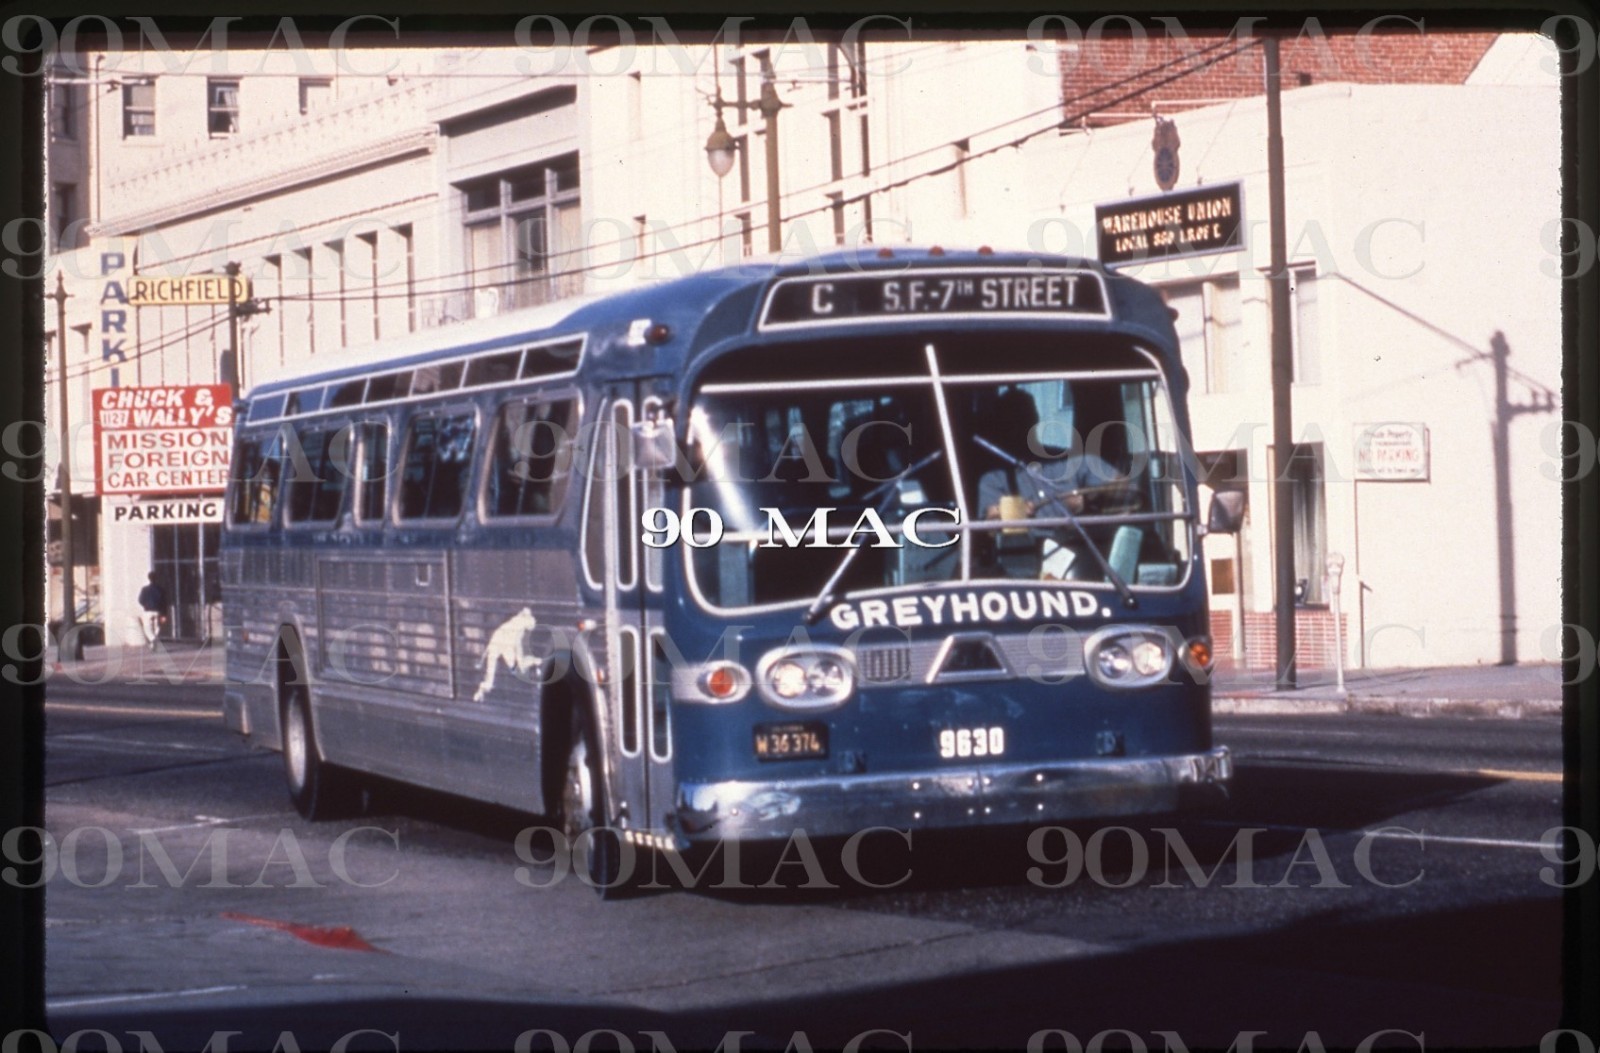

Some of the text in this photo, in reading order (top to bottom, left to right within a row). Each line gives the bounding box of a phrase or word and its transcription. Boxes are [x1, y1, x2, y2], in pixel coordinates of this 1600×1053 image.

[1102, 197, 1231, 234] WAREHOUSE UNION
[1116, 234, 1148, 252] LOCAL
[135, 280, 242, 301] RICHFIELD
[812, 283, 834, 313] C
[981, 276, 1079, 309] STREET
[101, 388, 214, 410] CHUCK &
[103, 405, 232, 427] 1127 WALLY'S
[107, 431, 228, 449] MISSION
[108, 450, 229, 469] FOREIGN
[108, 469, 230, 488] CAR CENTER
[115, 503, 217, 521] PARKING
[830, 591, 1111, 629] GREYHOUND.
[941, 727, 1004, 758] 9630
